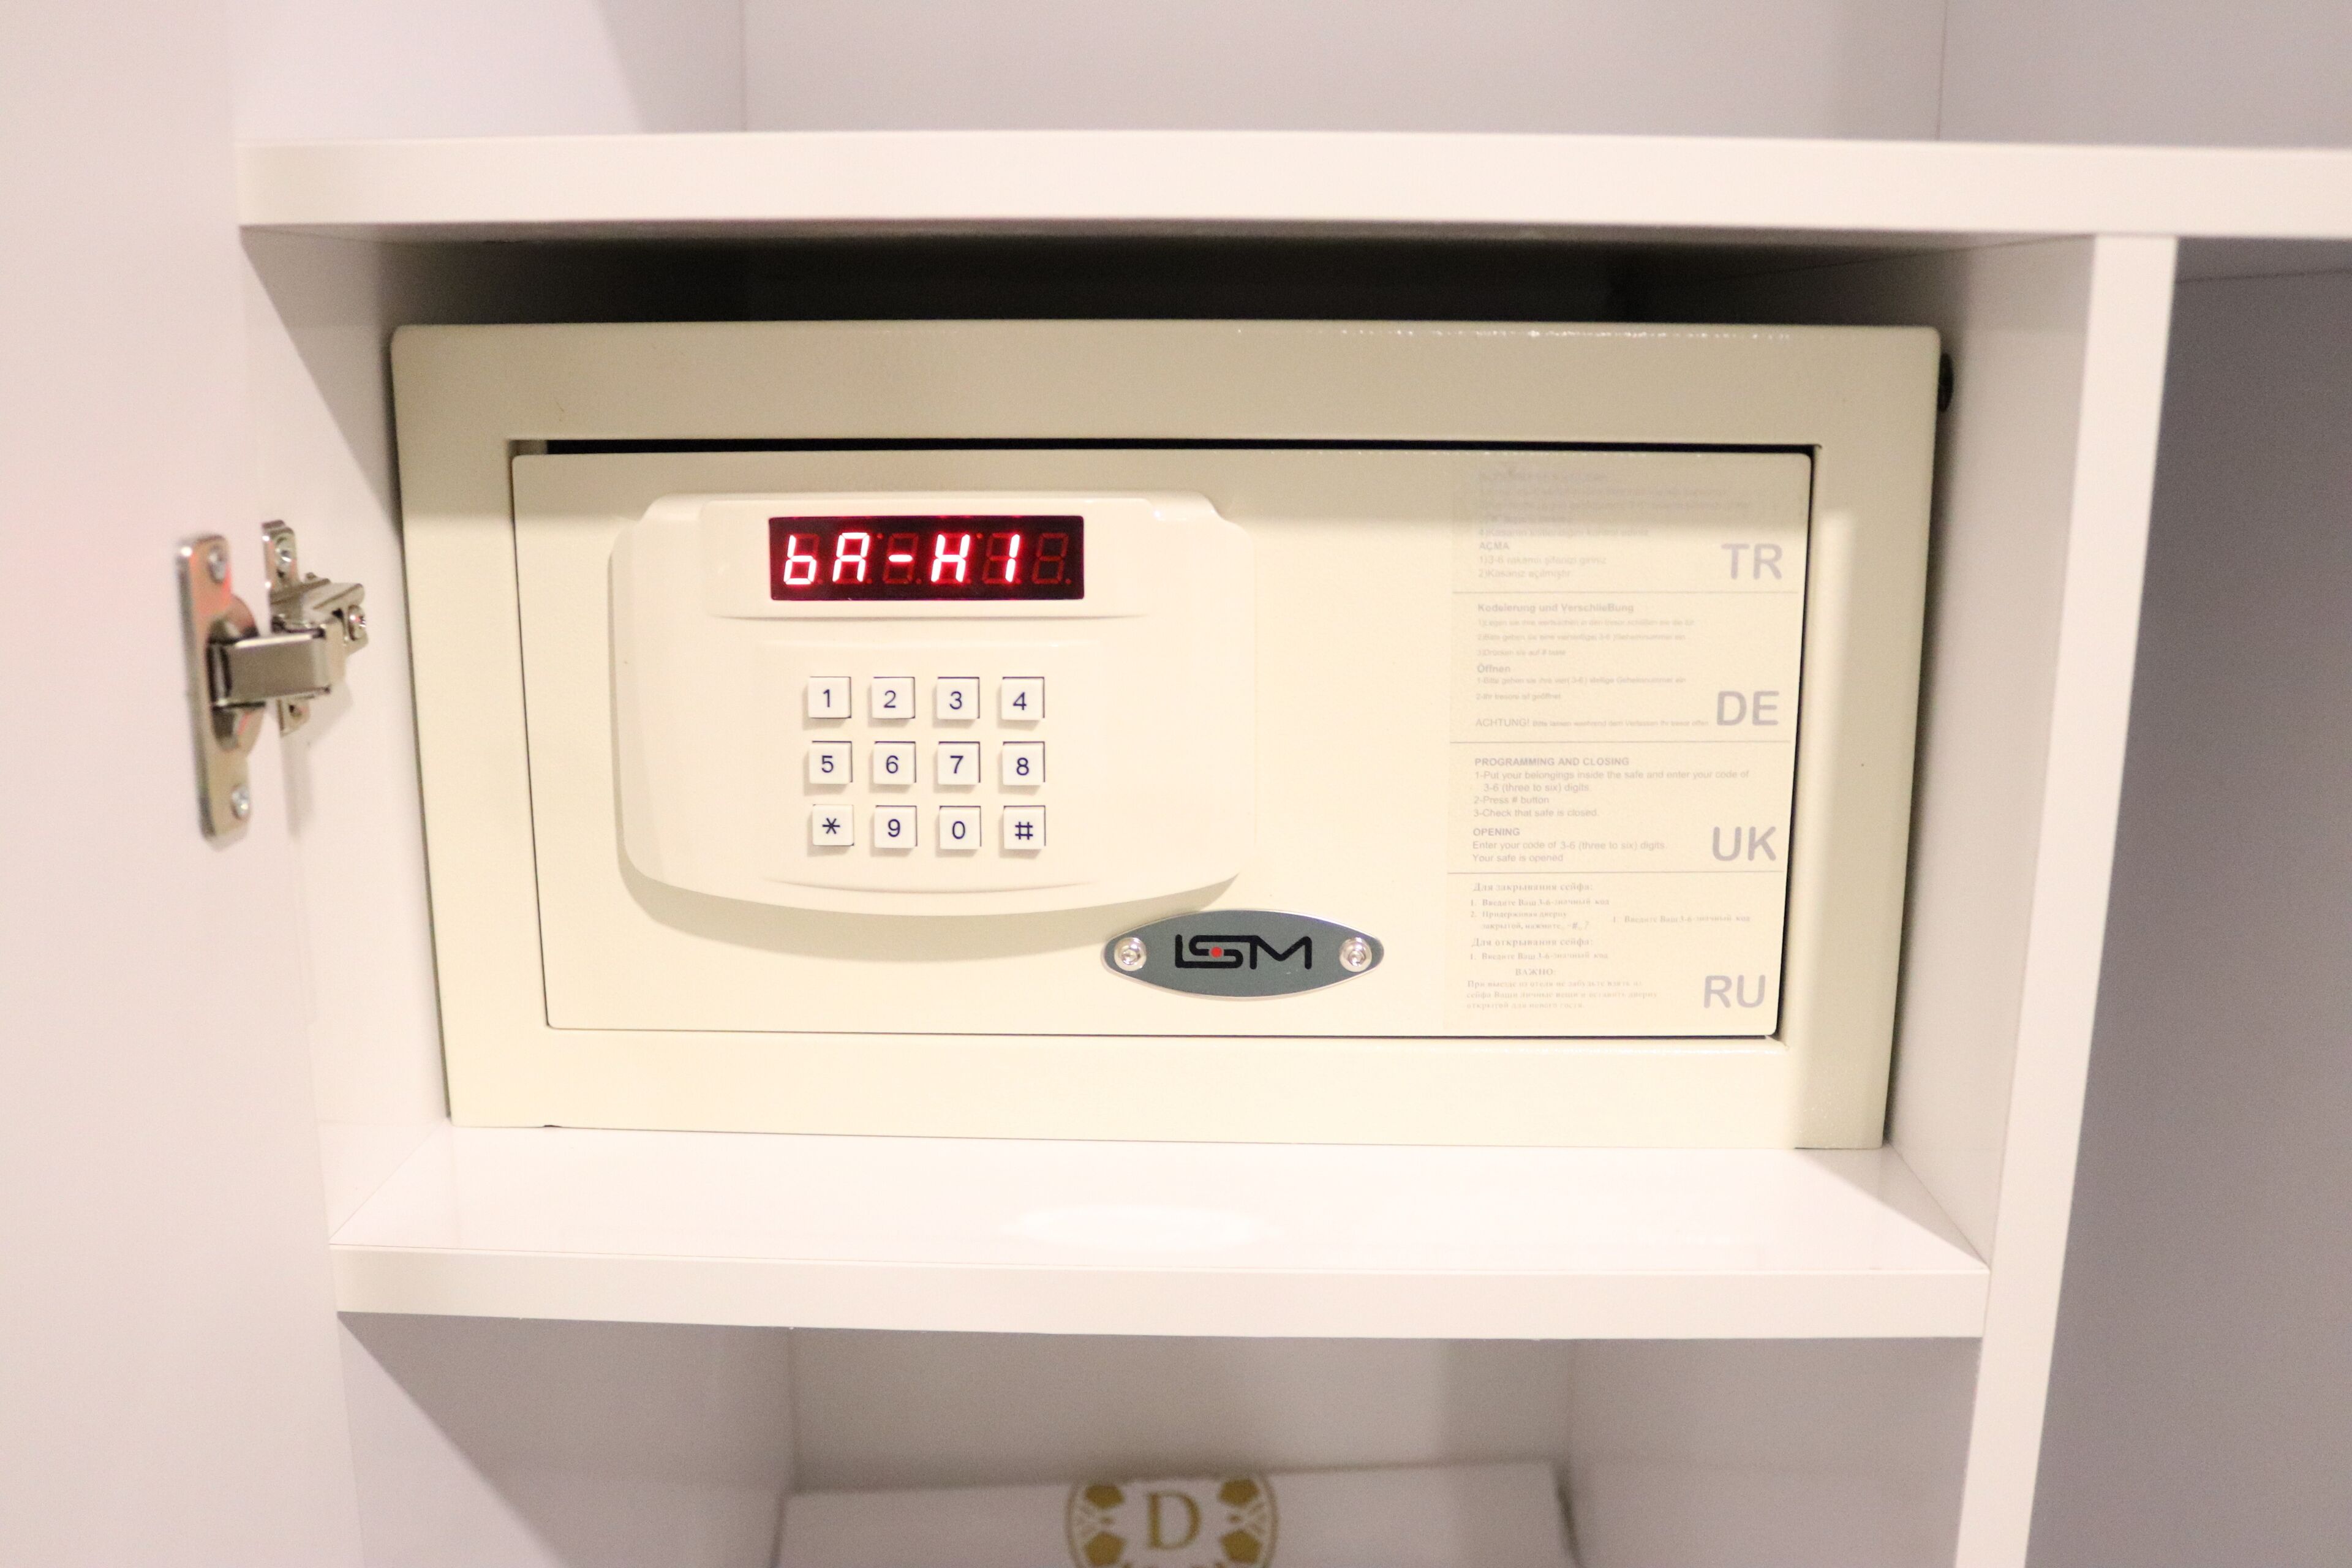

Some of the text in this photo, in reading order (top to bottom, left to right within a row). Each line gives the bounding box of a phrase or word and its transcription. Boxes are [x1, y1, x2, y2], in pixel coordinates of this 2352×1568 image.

[1721, 543, 1782, 579] TR
[1539, 603, 1558, 612] und
[1477, 663, 1511, 673] Öffnen
[823, 689, 1027, 710] 1 2 3 4
[1716, 691, 1780, 726] DE
[1476, 718, 1529, 727] ACHTUNG!
[821, 755, 1030, 775] 5 6 7 8
[1475, 757, 1629, 767] PROGRAMMING AND CLOSING
[1475, 771, 1499, 779] 1-Put
[1502, 772, 1521, 781] your
[1525, 771, 1574, 781] belongings
[1578, 771, 1604, 779] inside
[1607, 771, 1622, 779] the
[1624, 771, 1644, 779] safe
[1693, 772, 1713, 780] your
[1483, 783, 1499, 792] 3-6
[1502, 783, 1530, 794] (three
[1533, 783, 1542, 792] to
[1545, 783, 1562, 794] six)
[1474, 796, 1550, 805] 2-Press # button
[1474, 809, 1512, 818] 3-Check
[1515, 809, 1531, 818] that
[1535, 809, 1555, 818] safe
[1557, 809, 1564, 818] is
[888, 818, 901, 837] 9
[952, 821, 965, 840] 0
[1014, 821, 1033, 840] #
[1472, 827, 1520, 837] OPENING
[1472, 841, 1498, 850] Enter
[1501, 842, 1520, 851] your
[1523, 841, 1545, 850] code
[1547, 840, 1557, 850] of
[1560, 841, 1575, 850] 3-6
[1578, 840, 1606, 851] (three
[1609, 841, 1618, 850] to
[1621, 840, 1638, 851] six)
[1713, 826, 1776, 861] UK
[1472, 854, 1563, 864] Your safe is opened
[1472, 883, 1493, 892] Для
[1471, 938, 1491, 948] Для
[1703, 974, 1766, 1009] RU
[1147, 1490, 1201, 1551] D
